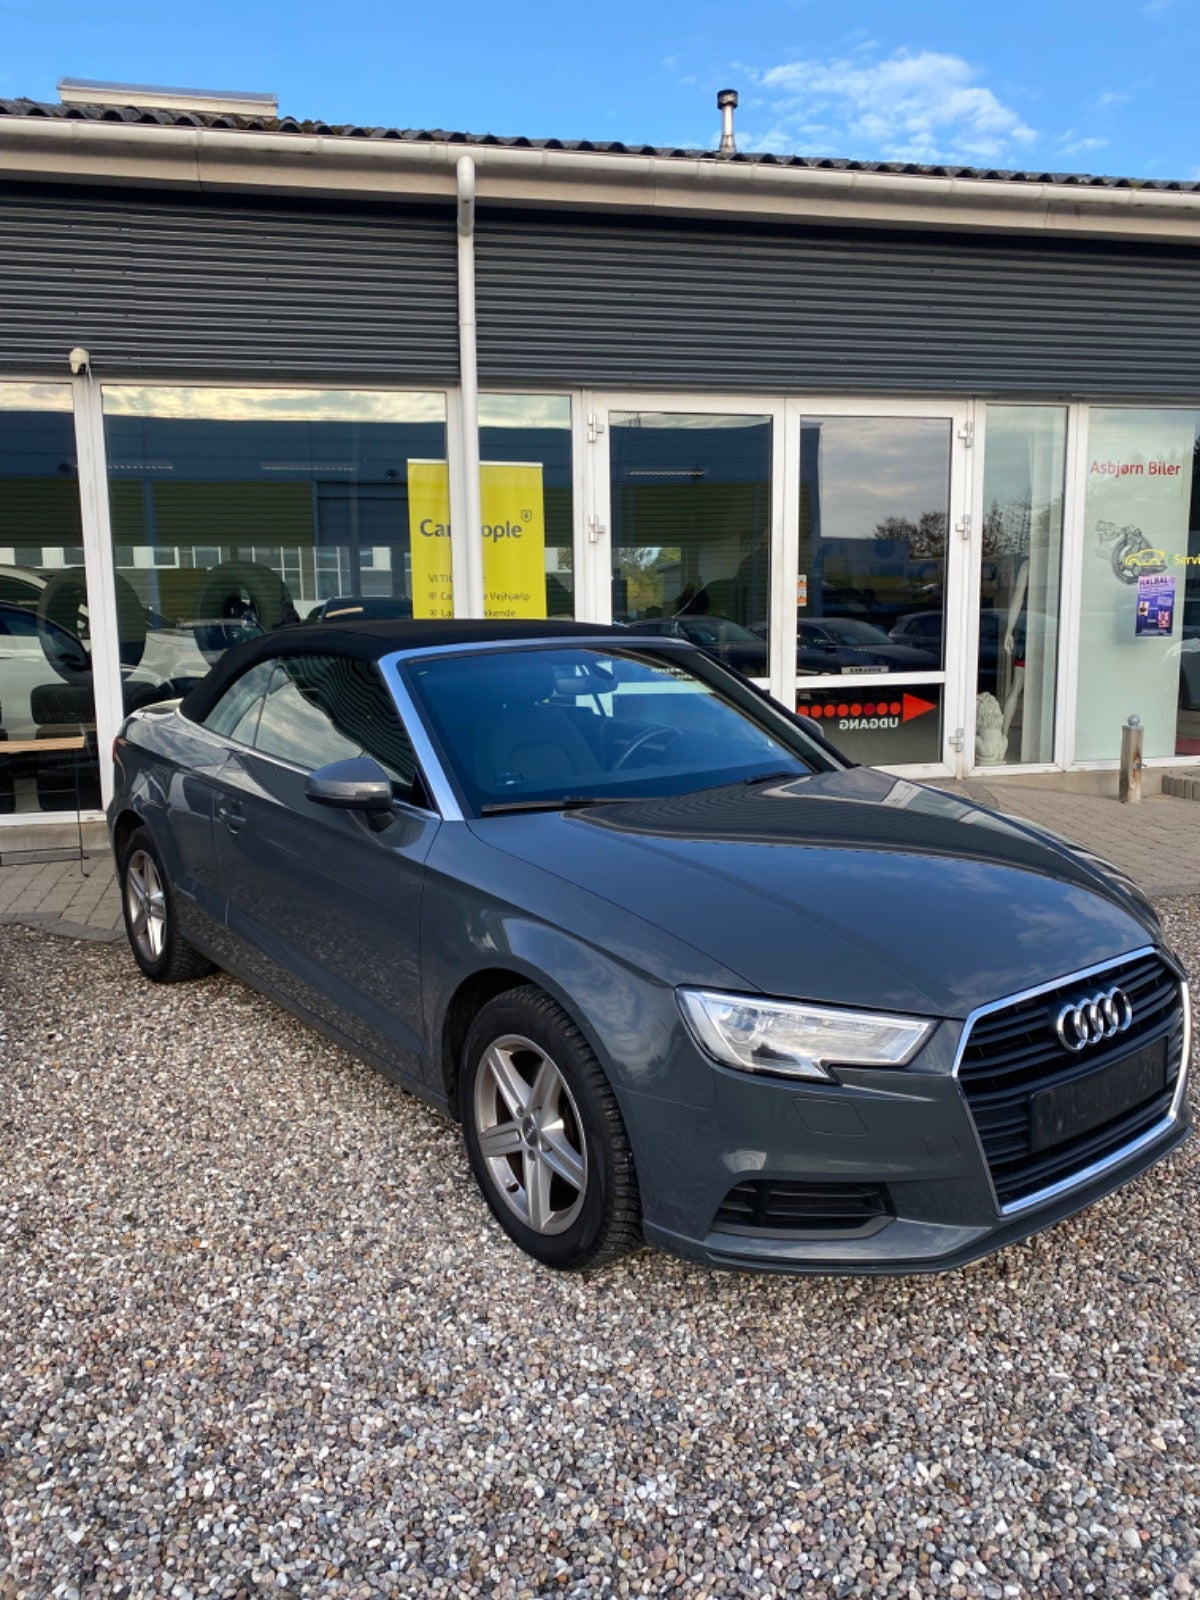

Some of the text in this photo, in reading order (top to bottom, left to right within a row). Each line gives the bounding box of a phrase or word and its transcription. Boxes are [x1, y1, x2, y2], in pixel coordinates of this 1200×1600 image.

[1089, 460, 1181, 478] Asbjørn Biler
[419, 519, 523, 544] Carople
